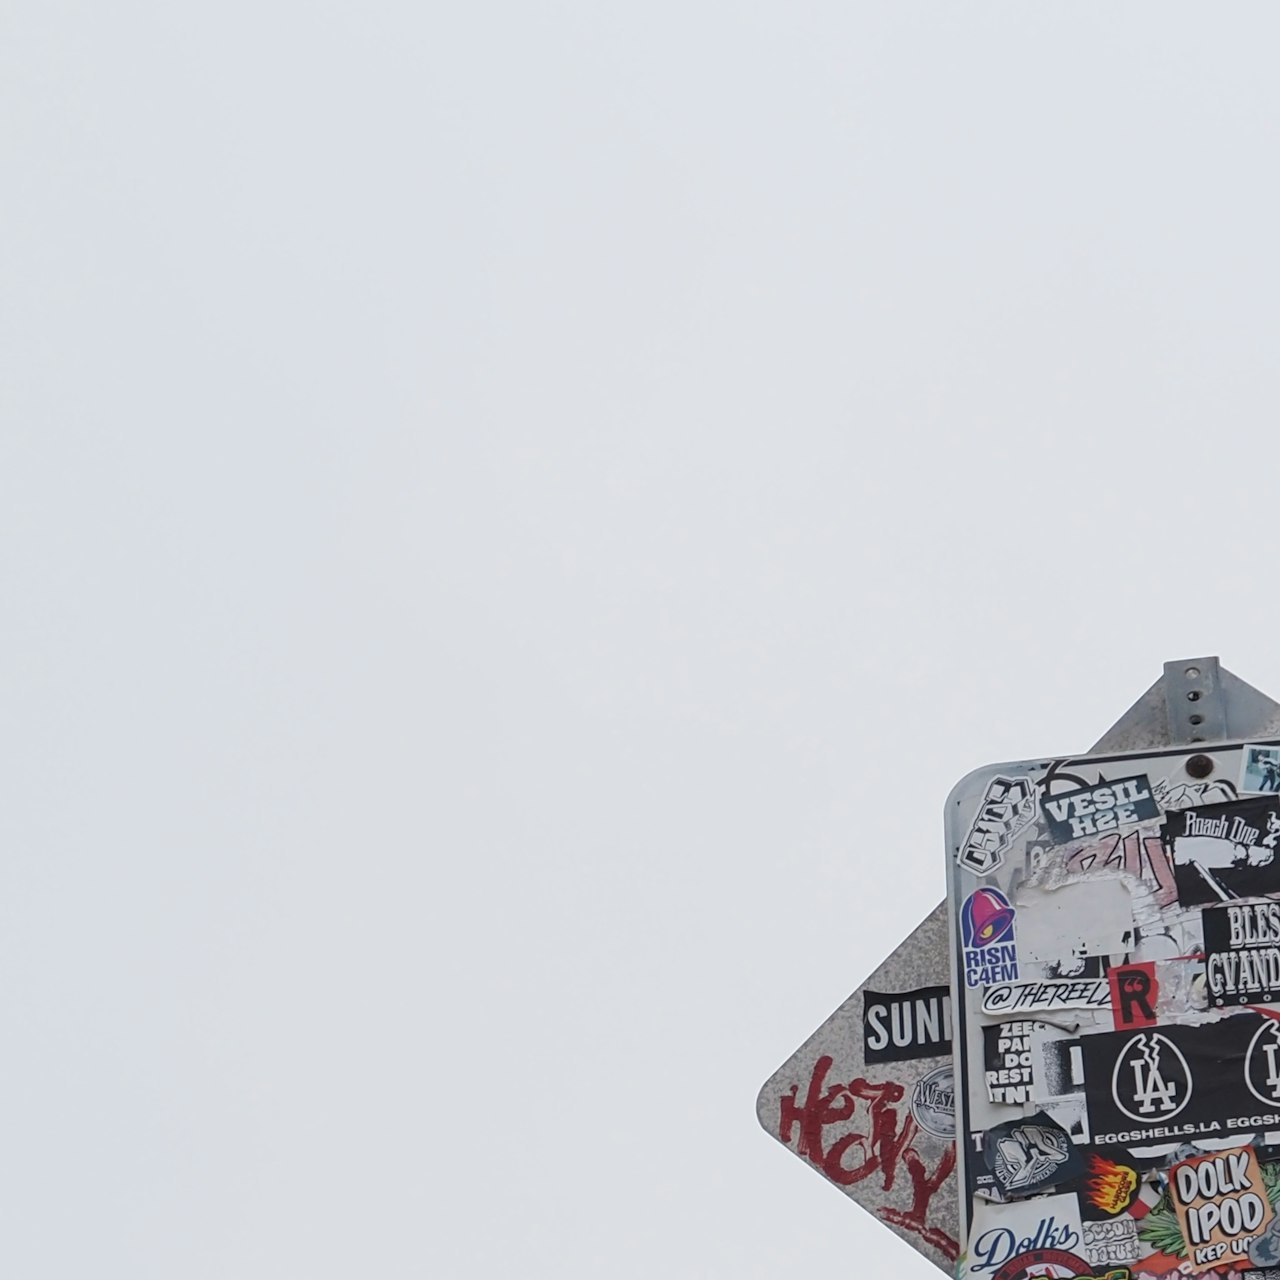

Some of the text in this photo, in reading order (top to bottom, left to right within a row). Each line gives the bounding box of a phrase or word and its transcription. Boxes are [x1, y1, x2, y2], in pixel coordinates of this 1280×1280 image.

[1045, 780, 1149, 822] VESIL
[1069, 803, 1139, 838] H2E
[1183, 811, 1260, 845] Roach One
[1095, 1120, 1222, 1145] EGGSHELLS.LA
[1176, 1150, 1253, 1204] DOLK
[1187, 1193, 1264, 1244] IPOD
